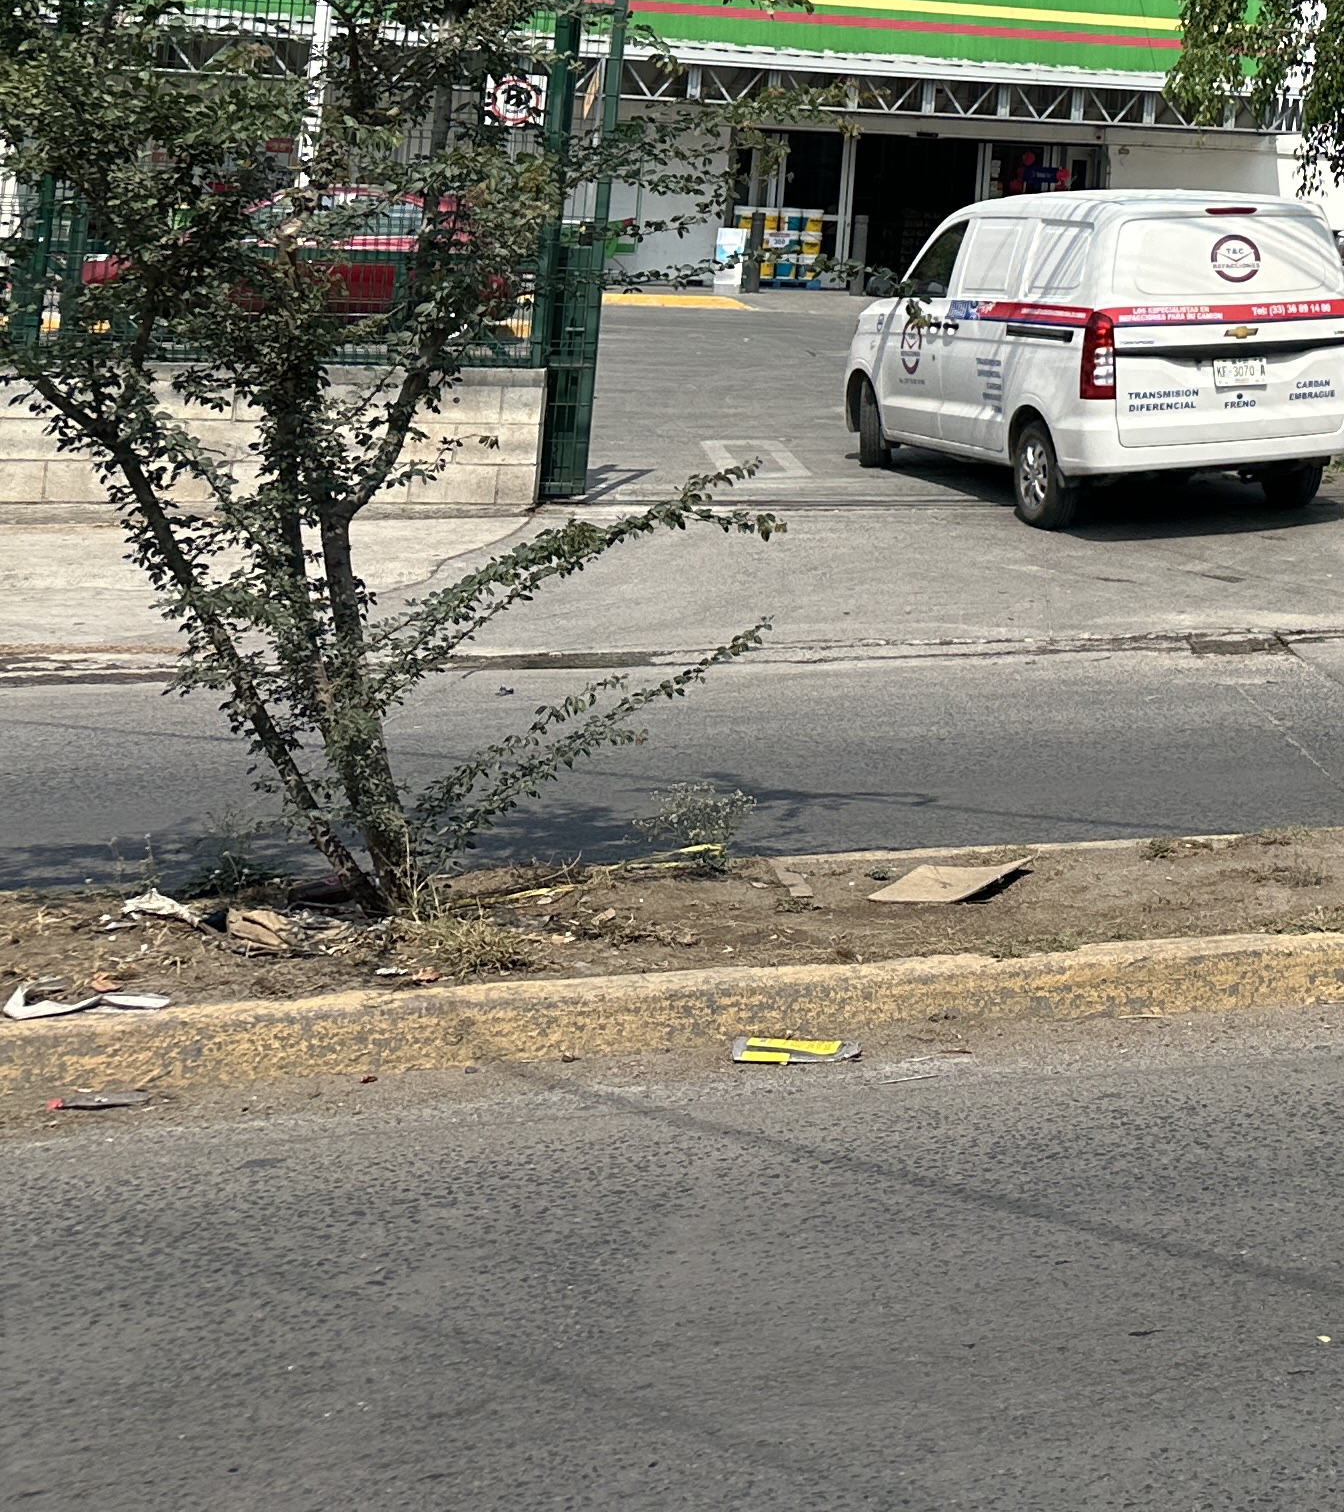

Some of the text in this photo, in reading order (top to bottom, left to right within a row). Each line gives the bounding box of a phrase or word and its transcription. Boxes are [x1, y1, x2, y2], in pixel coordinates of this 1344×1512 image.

[1269, 304, 1286, 317] (33)
[1127, 389, 1200, 400] TRANSMISION
[1128, 401, 1197, 412] DIFERENCIAL
[1224, 399, 1257, 409] FRENO
